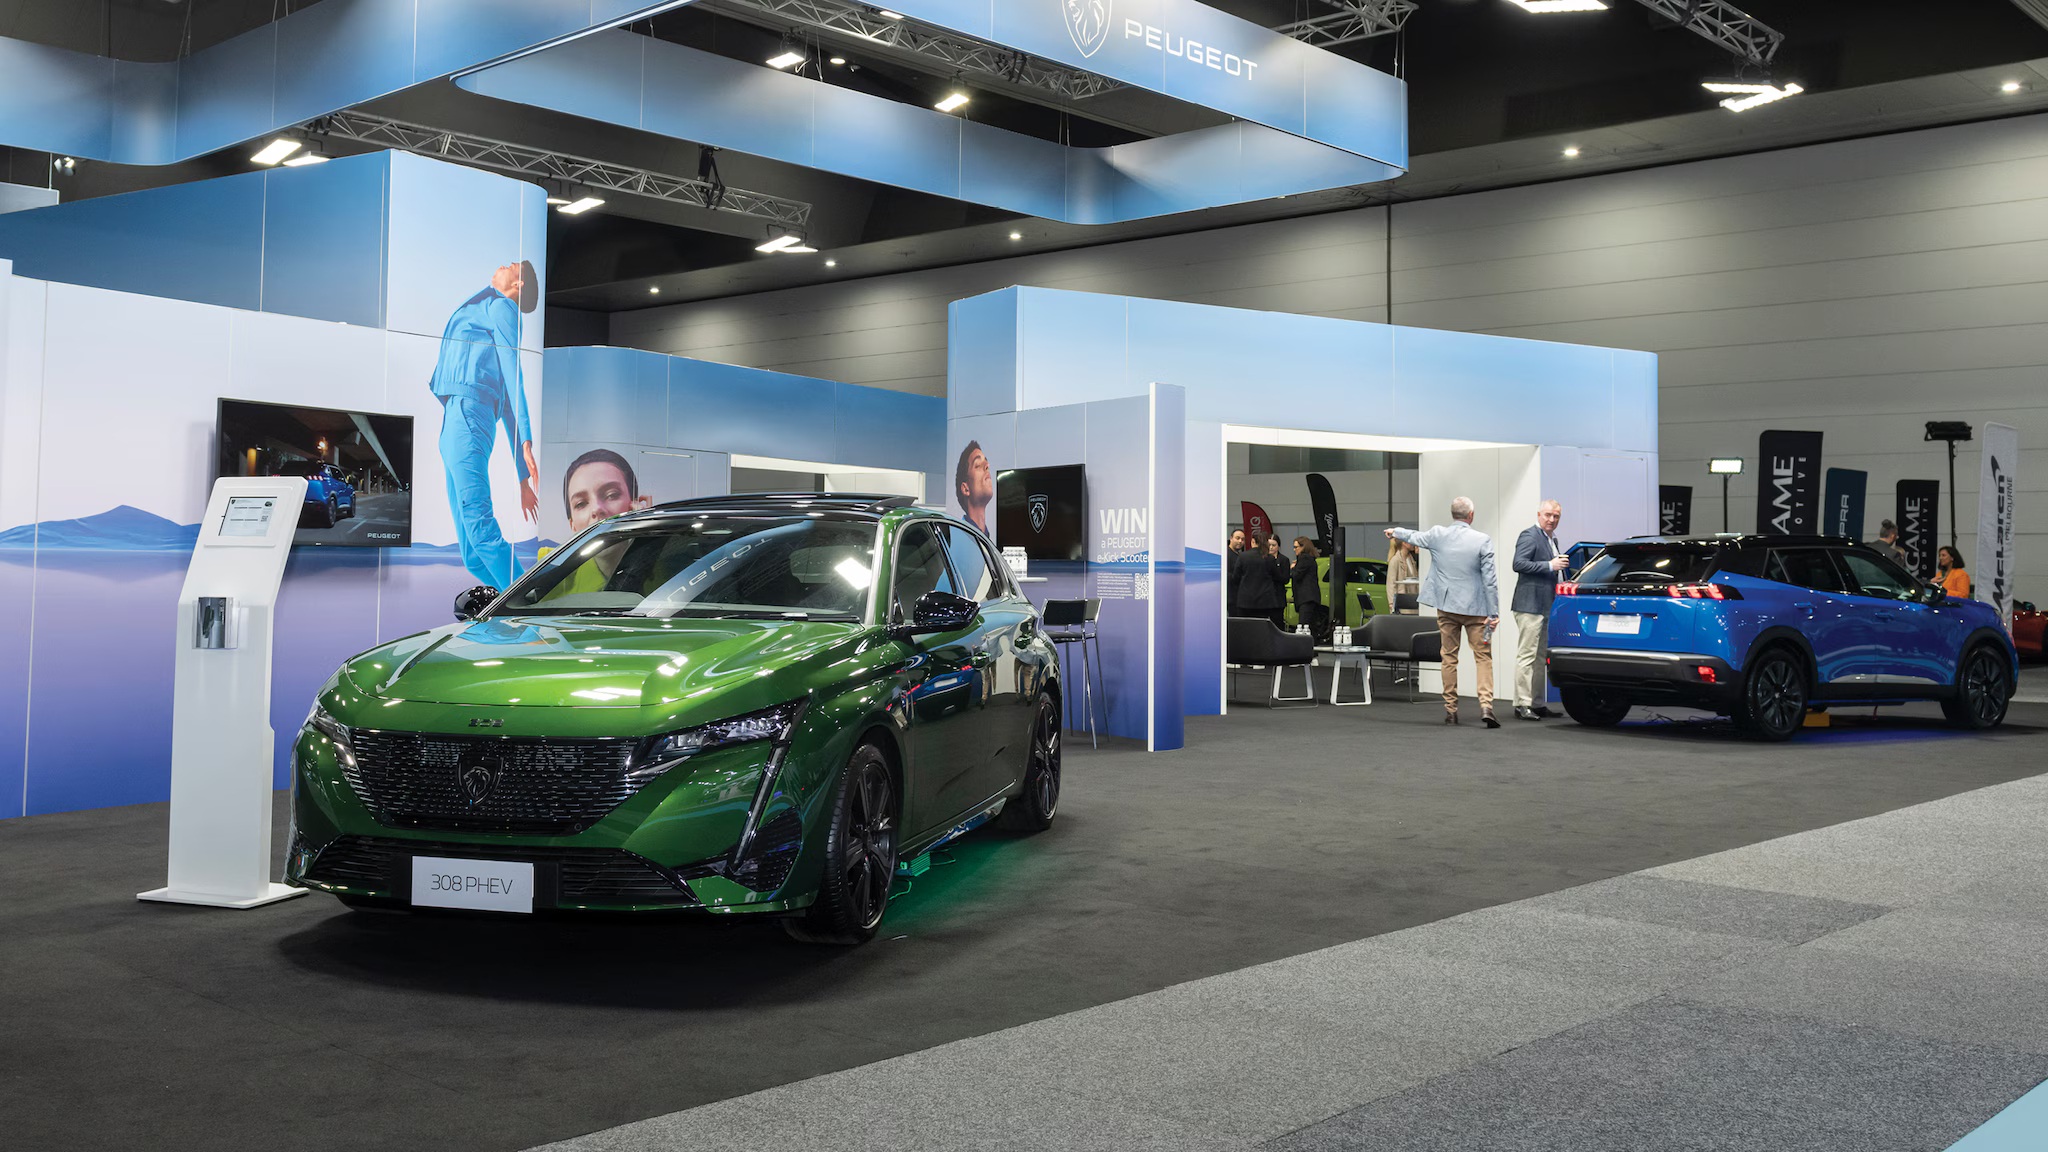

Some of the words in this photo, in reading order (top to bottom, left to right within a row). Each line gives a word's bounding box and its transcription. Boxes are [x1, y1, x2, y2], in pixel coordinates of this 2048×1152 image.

[1125, 18, 1258, 81] PEUGEOT
[1100, 508, 1147, 534] WIN
[1839, 494, 1850, 538] PRA
[2005, 477, 2013, 541] MELBOURNE
[1097, 551, 1118, 563] e-Kick
[1101, 540, 1106, 548] a
[1107, 537, 1146, 548] PEUGEOT
[1992, 475, 2005, 614] McLaren
[431, 873, 463, 892] 308
[465, 876, 514, 895] PHEV
